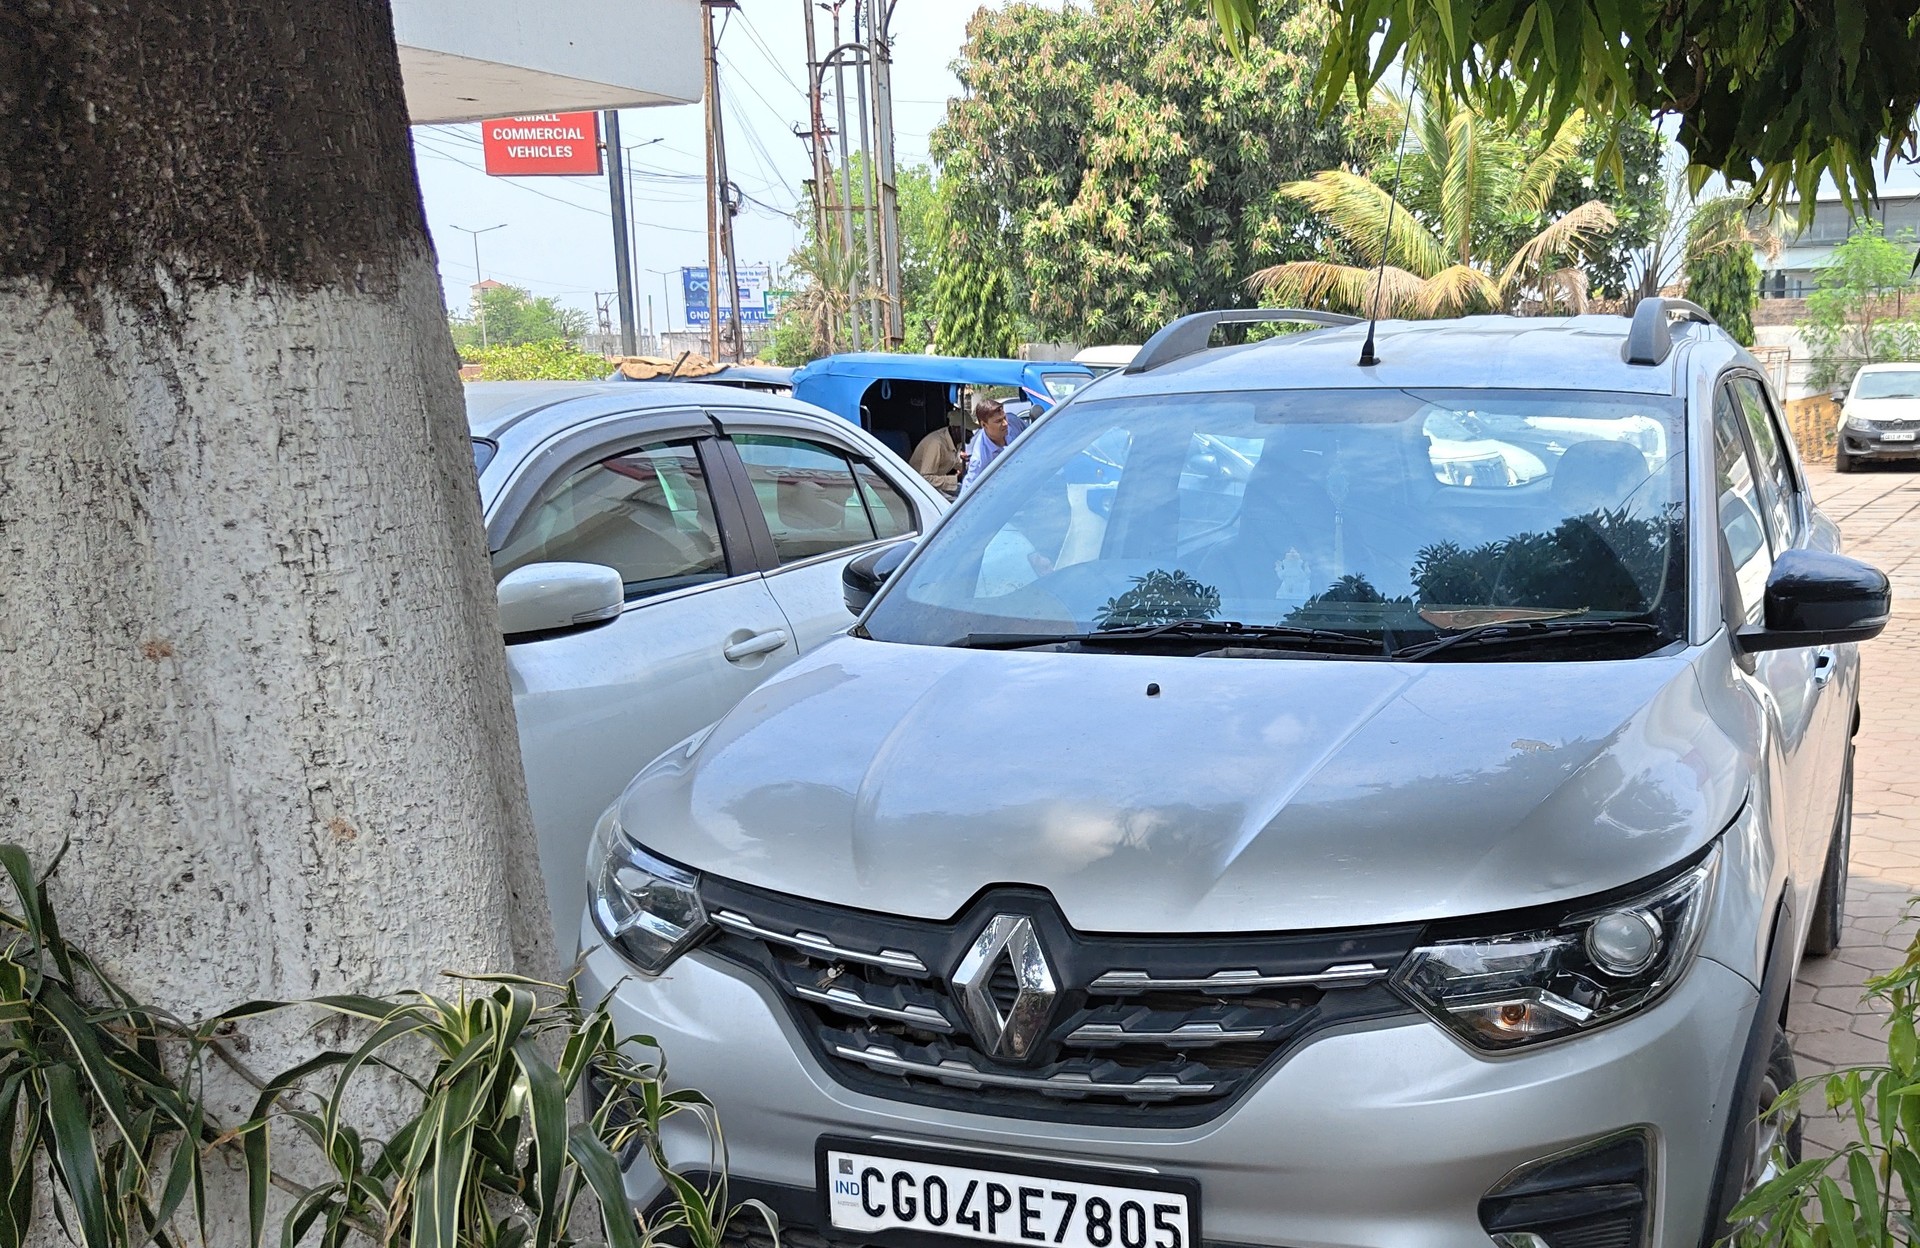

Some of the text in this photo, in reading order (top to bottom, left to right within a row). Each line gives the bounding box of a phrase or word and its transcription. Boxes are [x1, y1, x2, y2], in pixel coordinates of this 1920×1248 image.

[493, 127, 585, 140] COMMERCIAL
[507, 146, 573, 158] VEHICLES
[690, 311, 710, 320] GND
[835, 1180, 860, 1196] IND
[861, 1166, 1182, 1248] CG04PE7805
